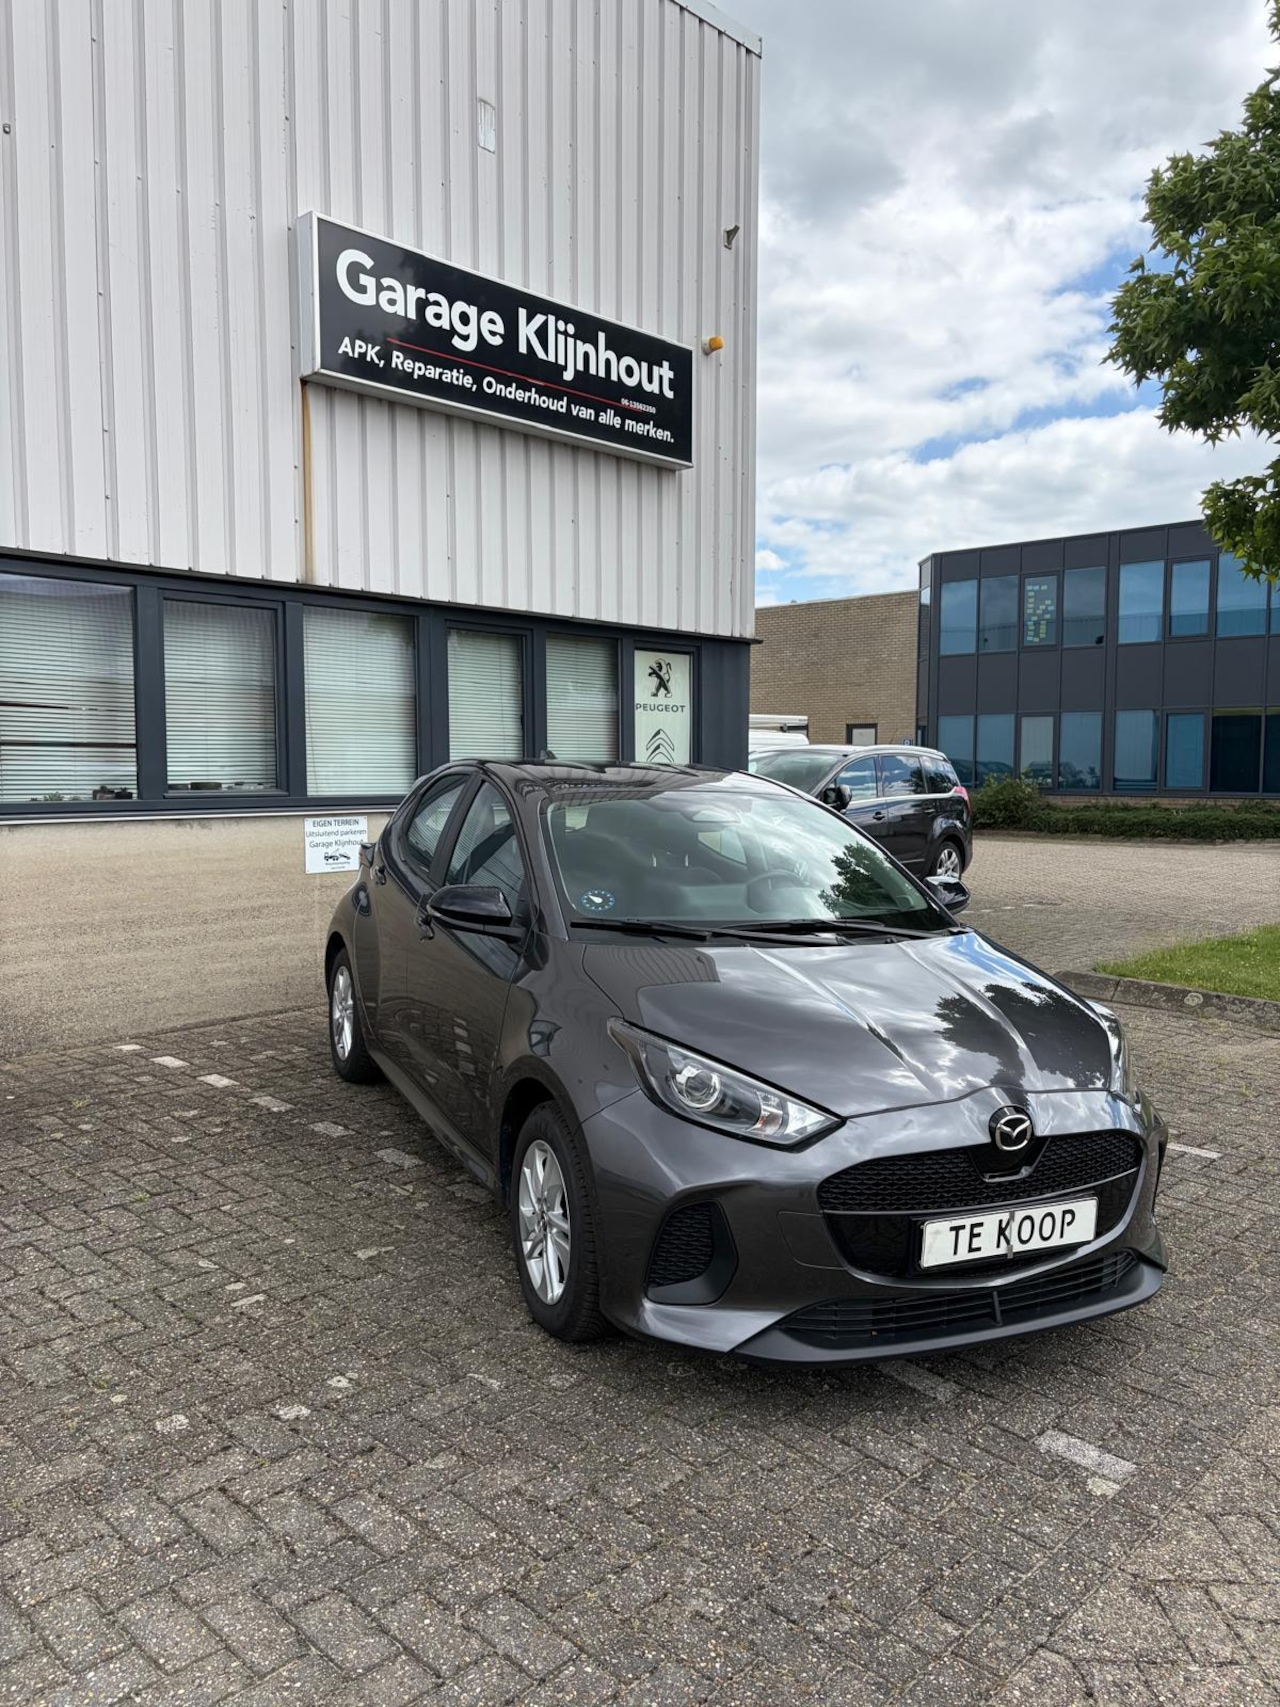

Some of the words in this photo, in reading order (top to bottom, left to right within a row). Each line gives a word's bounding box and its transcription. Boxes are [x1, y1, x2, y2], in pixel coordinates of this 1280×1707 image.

[336, 249, 505, 352] Garage
[518, 306, 675, 399] Klijnhout
[338, 336, 385, 368] APK,
[391, 350, 477, 392] Reparatie,
[482, 376, 567, 413] Onderhoud
[571, 403, 595, 421] van
[598, 408, 621, 429] alle
[624, 419, 675, 443] merken.
[635, 703, 686, 713] PEUGEOT
[312, 819, 332, 828] EIGEN
[333, 818, 359, 827] TERREIN
[340, 829, 367, 837] parkeren
[309, 840, 333, 849] Garage
[949, 1222, 984, 1256] TE
[996, 1208, 1076, 1249] KOOP
